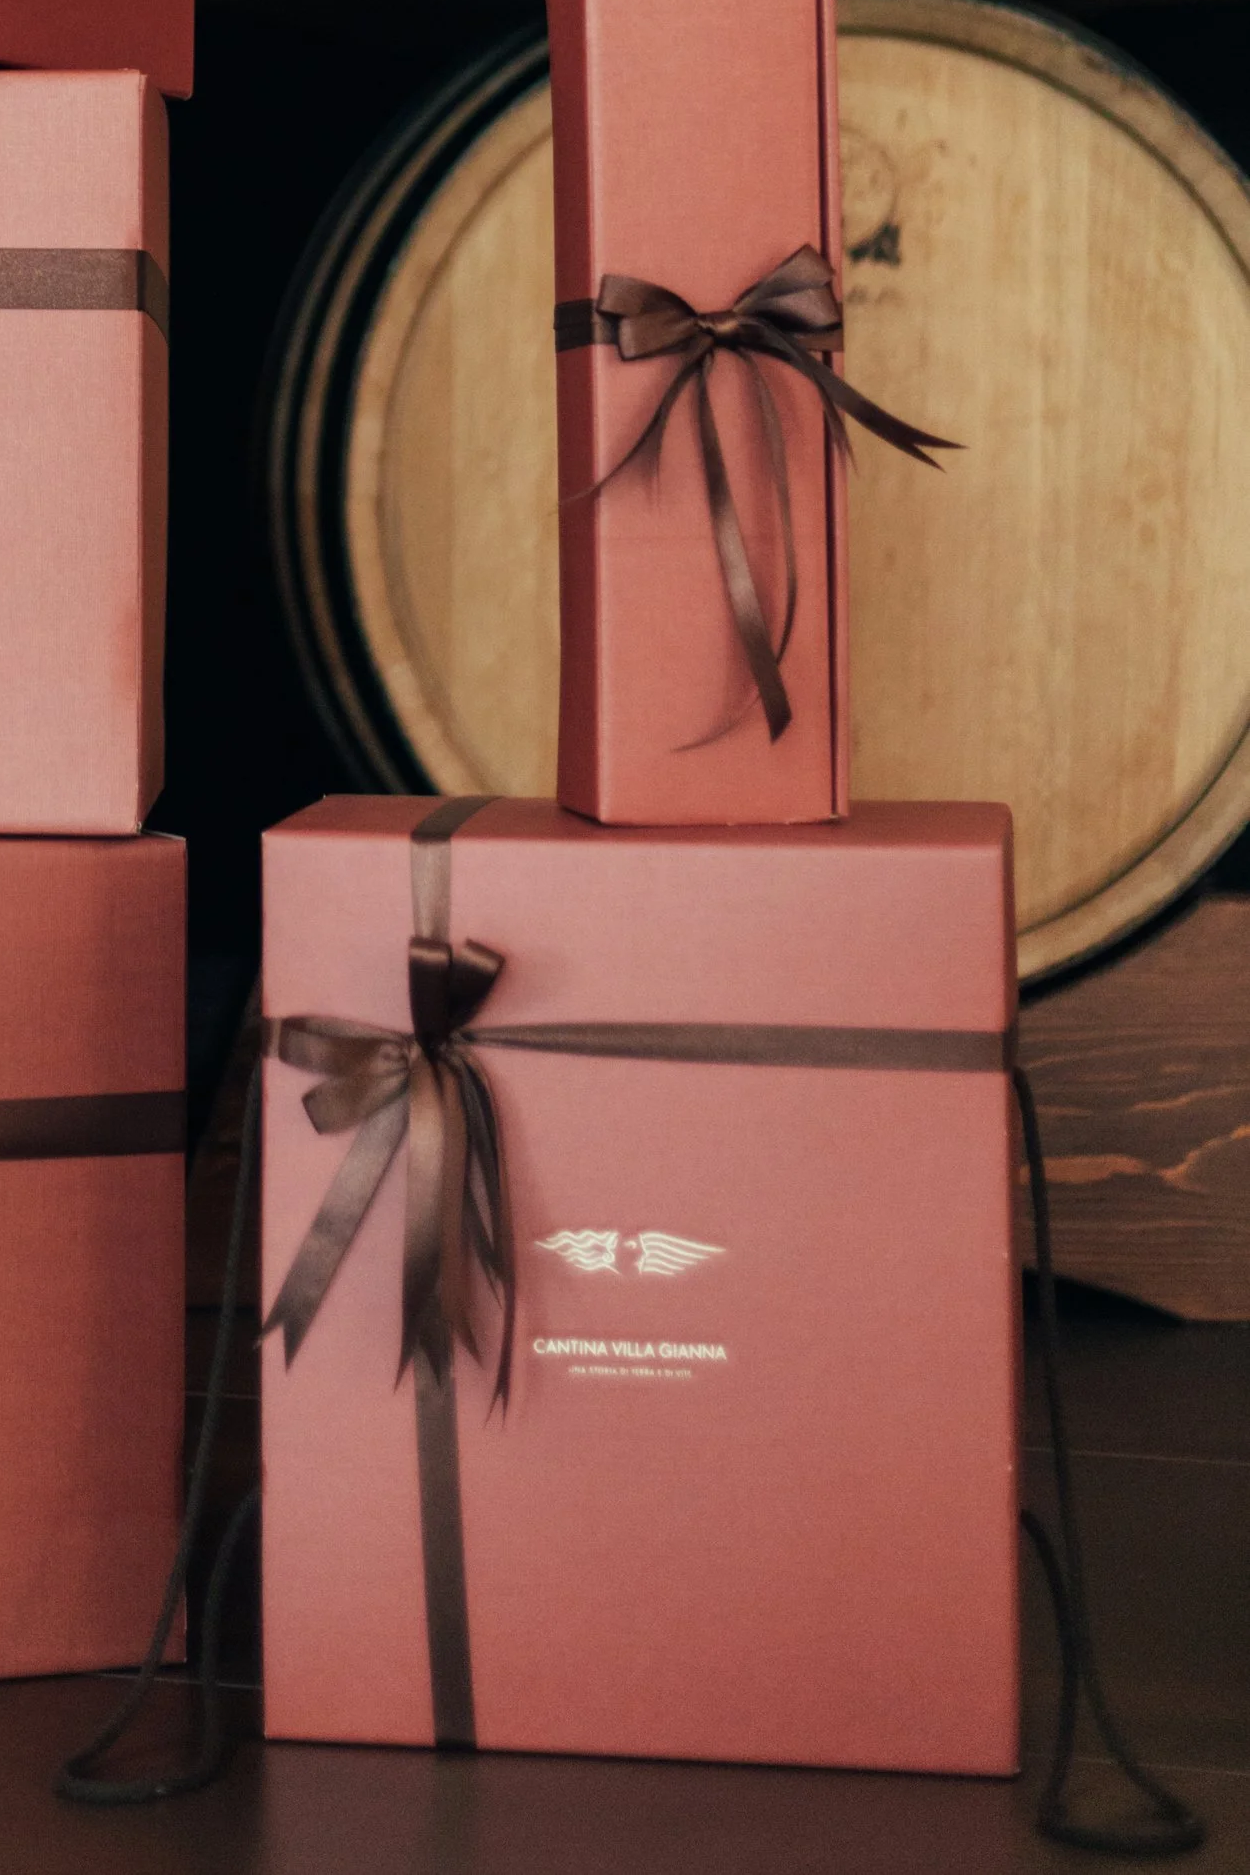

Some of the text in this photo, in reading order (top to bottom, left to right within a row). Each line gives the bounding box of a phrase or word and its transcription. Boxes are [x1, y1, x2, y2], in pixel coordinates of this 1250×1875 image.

[533, 1338, 727, 1360] CANTINA VILLA GIANNA
